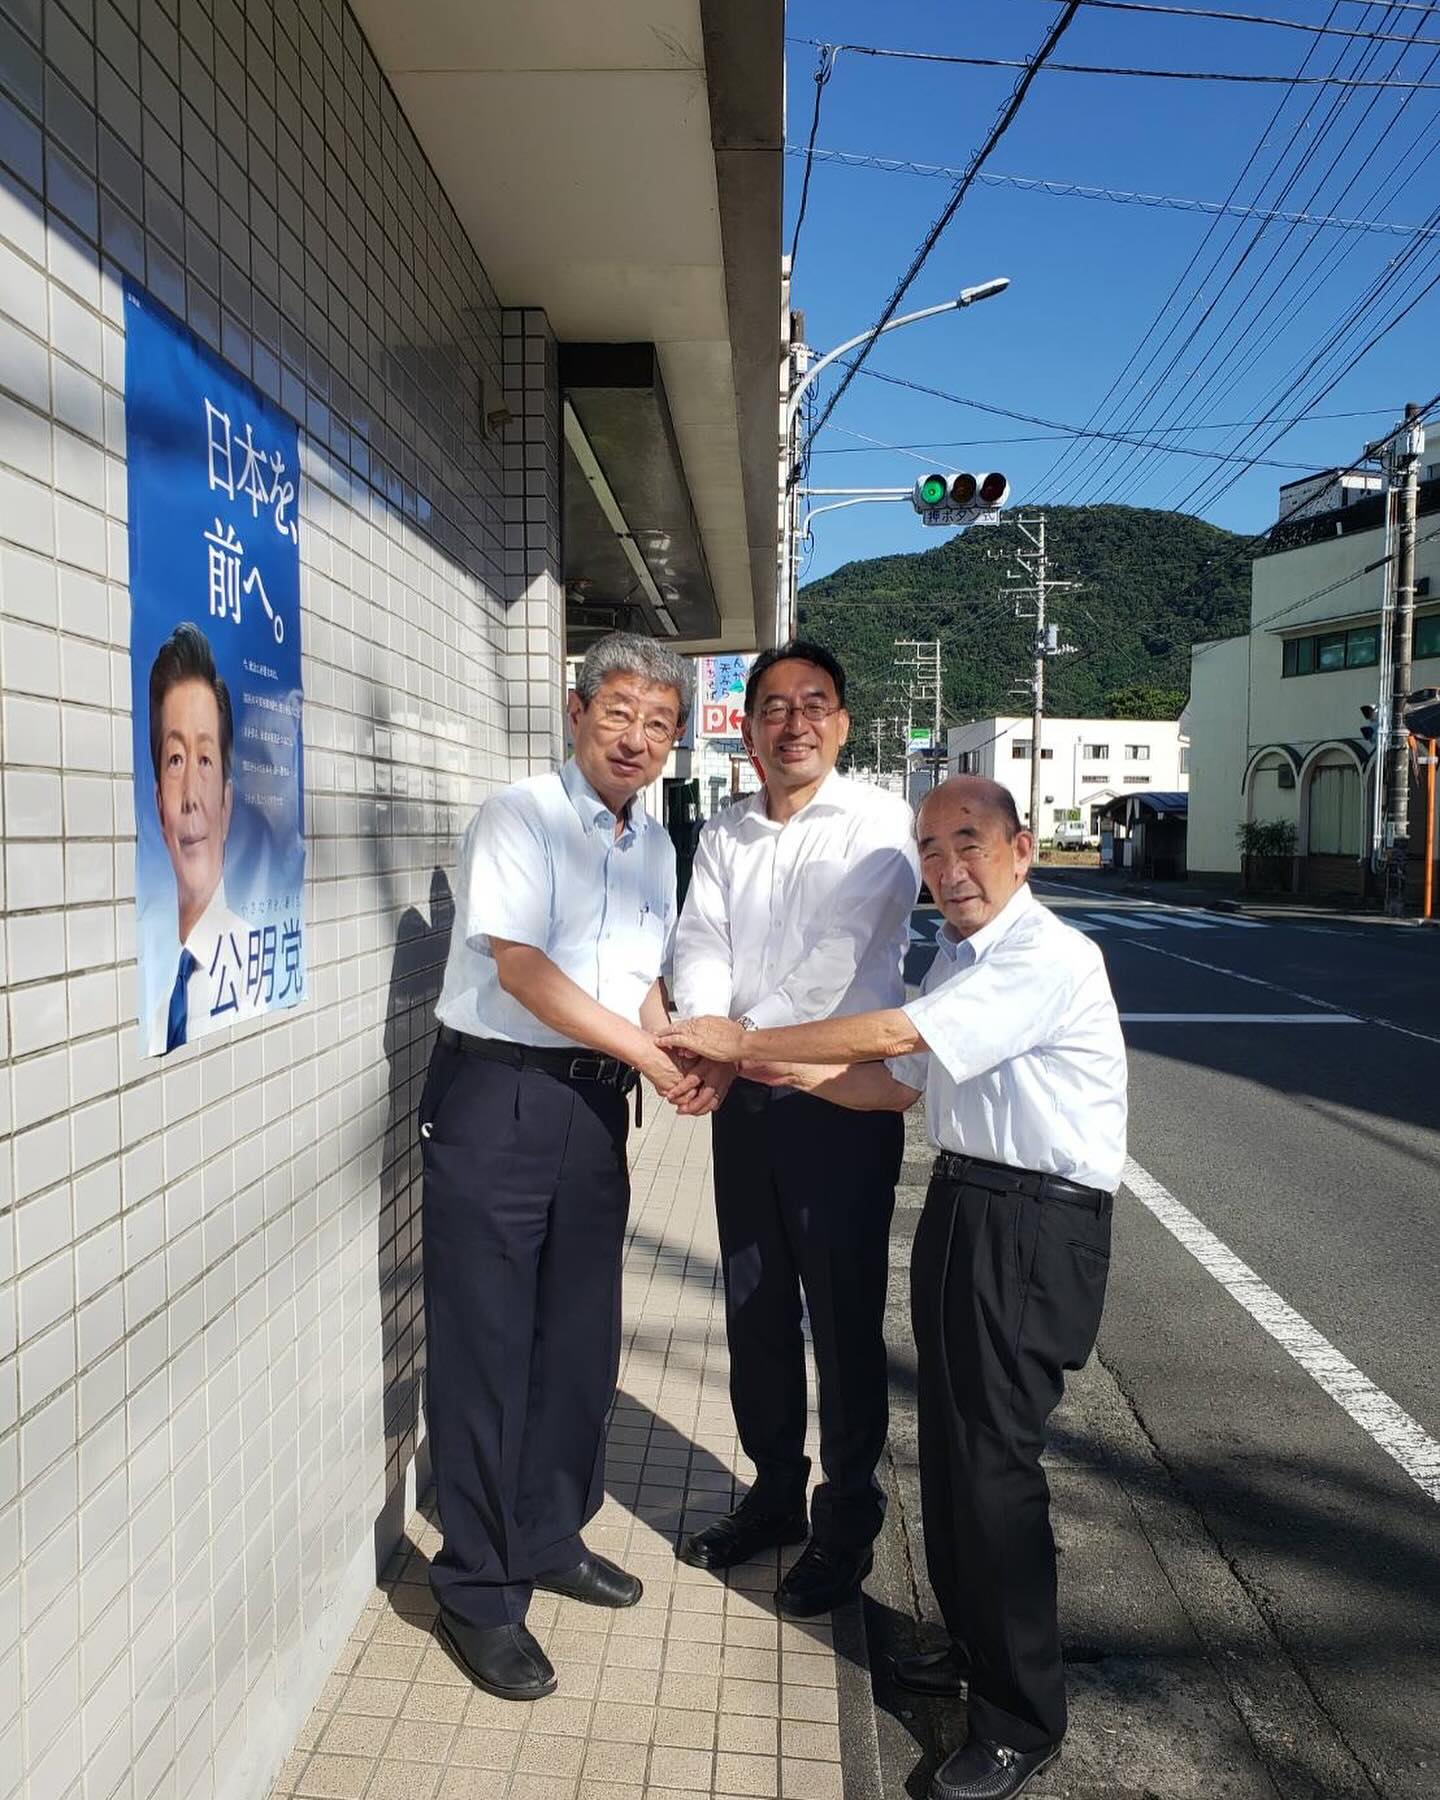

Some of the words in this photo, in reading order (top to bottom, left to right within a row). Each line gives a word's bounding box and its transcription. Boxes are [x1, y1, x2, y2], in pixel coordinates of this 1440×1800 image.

[205, 397, 298, 545] 日本を、
[204, 517, 284, 644] 前へ。
[706, 709, 724, 731] P
[209, 917, 303, 1017] 公明党
